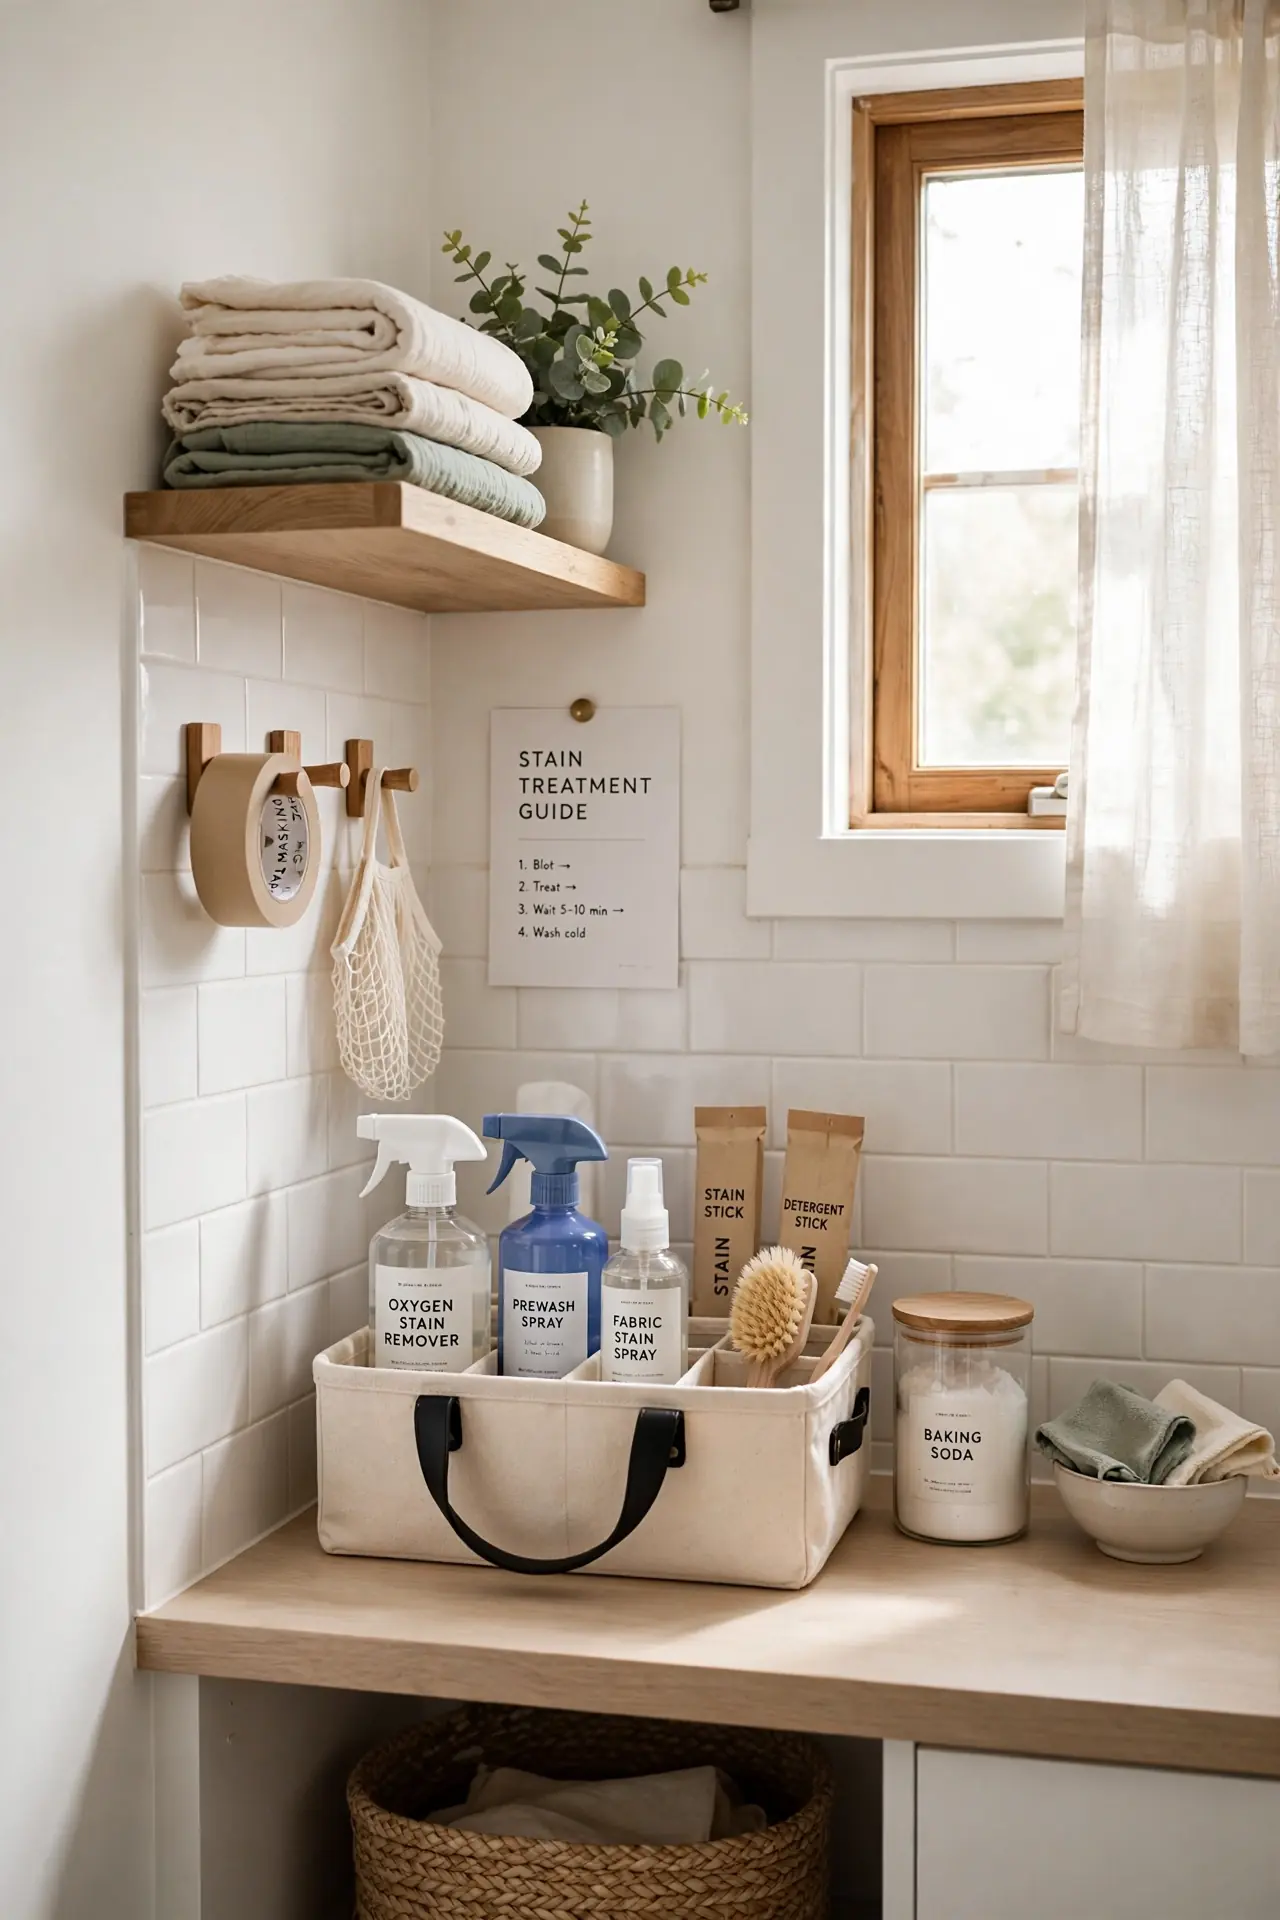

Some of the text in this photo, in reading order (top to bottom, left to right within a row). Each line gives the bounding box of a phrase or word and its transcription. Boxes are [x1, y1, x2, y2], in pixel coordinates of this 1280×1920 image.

[518, 750, 583, 768] STAIN
[518, 777, 652, 794] TREATMENT
[518, 803, 588, 820] GUIDE
[518, 859, 554, 870] 1. Blot
[518, 881, 561, 892] 2. Treat
[518, 904, 608, 916] 3. Wait 5-10 min
[518, 927, 586, 939] 4. Wash cold
[704, 1188, 745, 1201] STAIN
[704, 1205, 744, 1219] STICK
[783, 1198, 845, 1216] DETERGENT
[794, 1216, 828, 1231] STICK
[714, 1237, 730, 1296] STAIN
[388, 1298, 453, 1312] OXYGEN
[512, 1298, 575, 1312] PREWASH
[399, 1316, 445, 1330] STAIN
[521, 1316, 563, 1329] SPRAY
[613, 1315, 662, 1328] FABRIC
[384, 1332, 459, 1347] REMOVER
[614, 1331, 653, 1345] STAIN
[614, 1347, 657, 1361] SPRAY
[924, 1428, 982, 1444] BAKING
[930, 1446, 974, 1461] SODA
